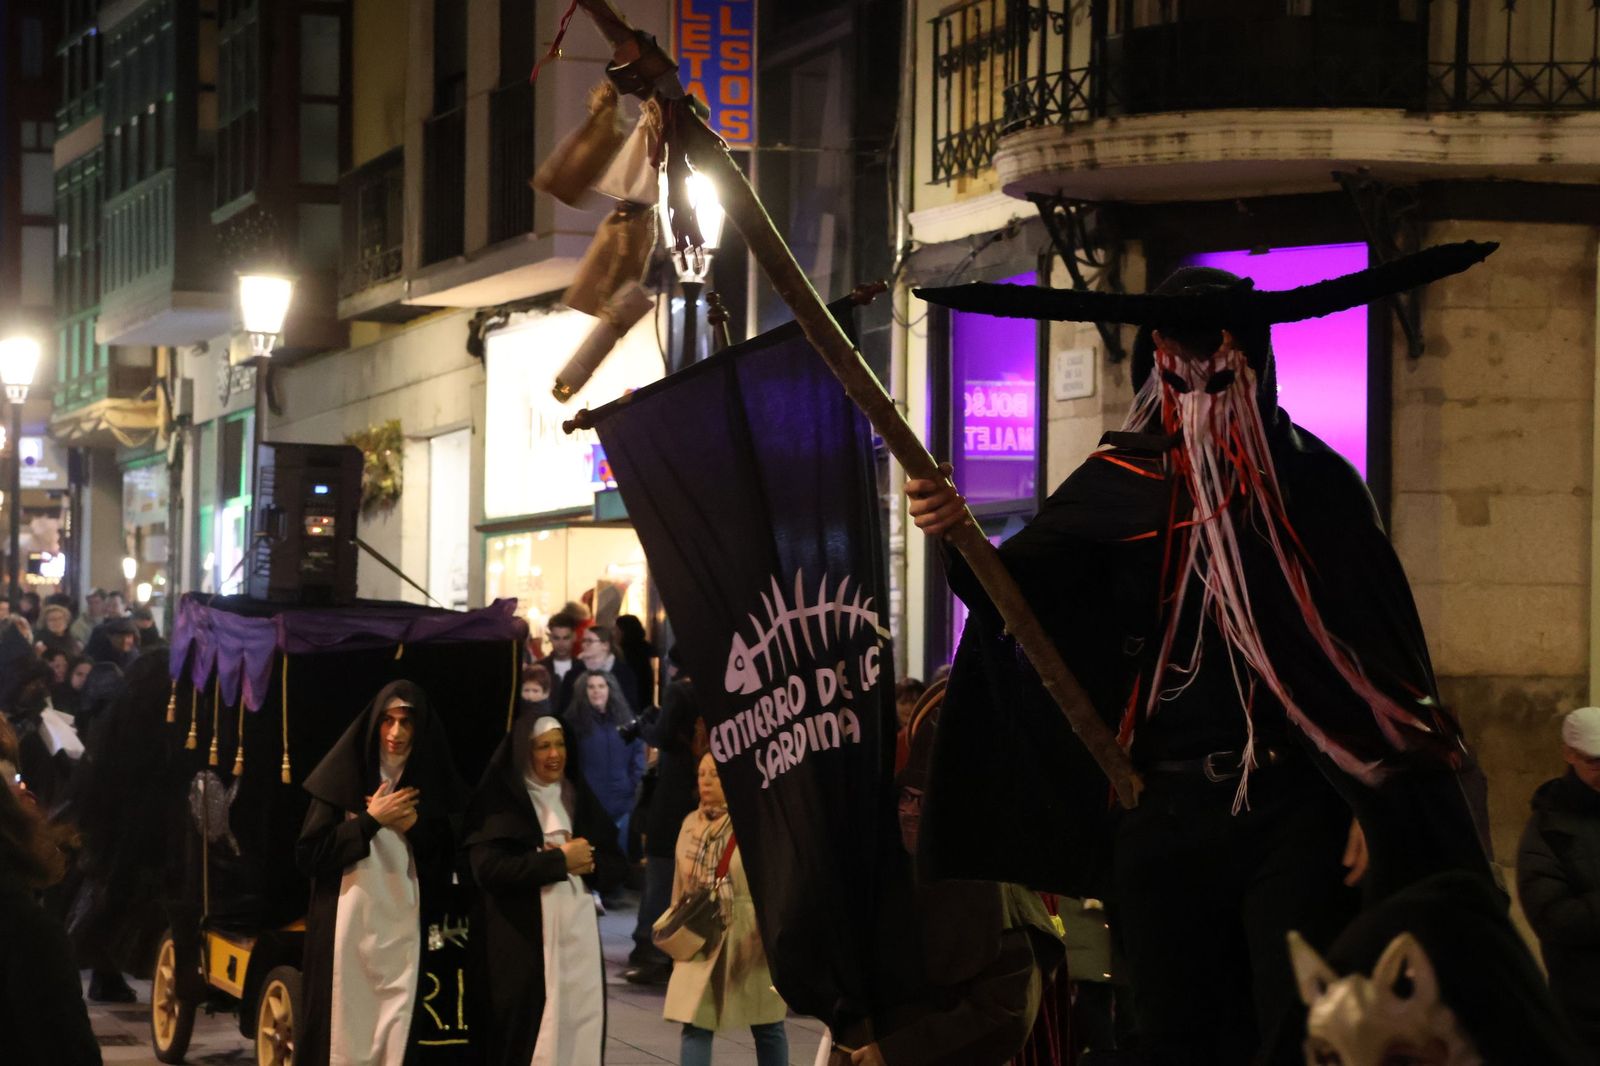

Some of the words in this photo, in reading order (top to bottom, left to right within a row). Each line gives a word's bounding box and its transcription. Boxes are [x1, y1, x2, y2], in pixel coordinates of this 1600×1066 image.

[709, 675, 807, 764] ENTIERRO
[815, 659, 854, 707] DE
[755, 707, 861, 789] SARDINA
